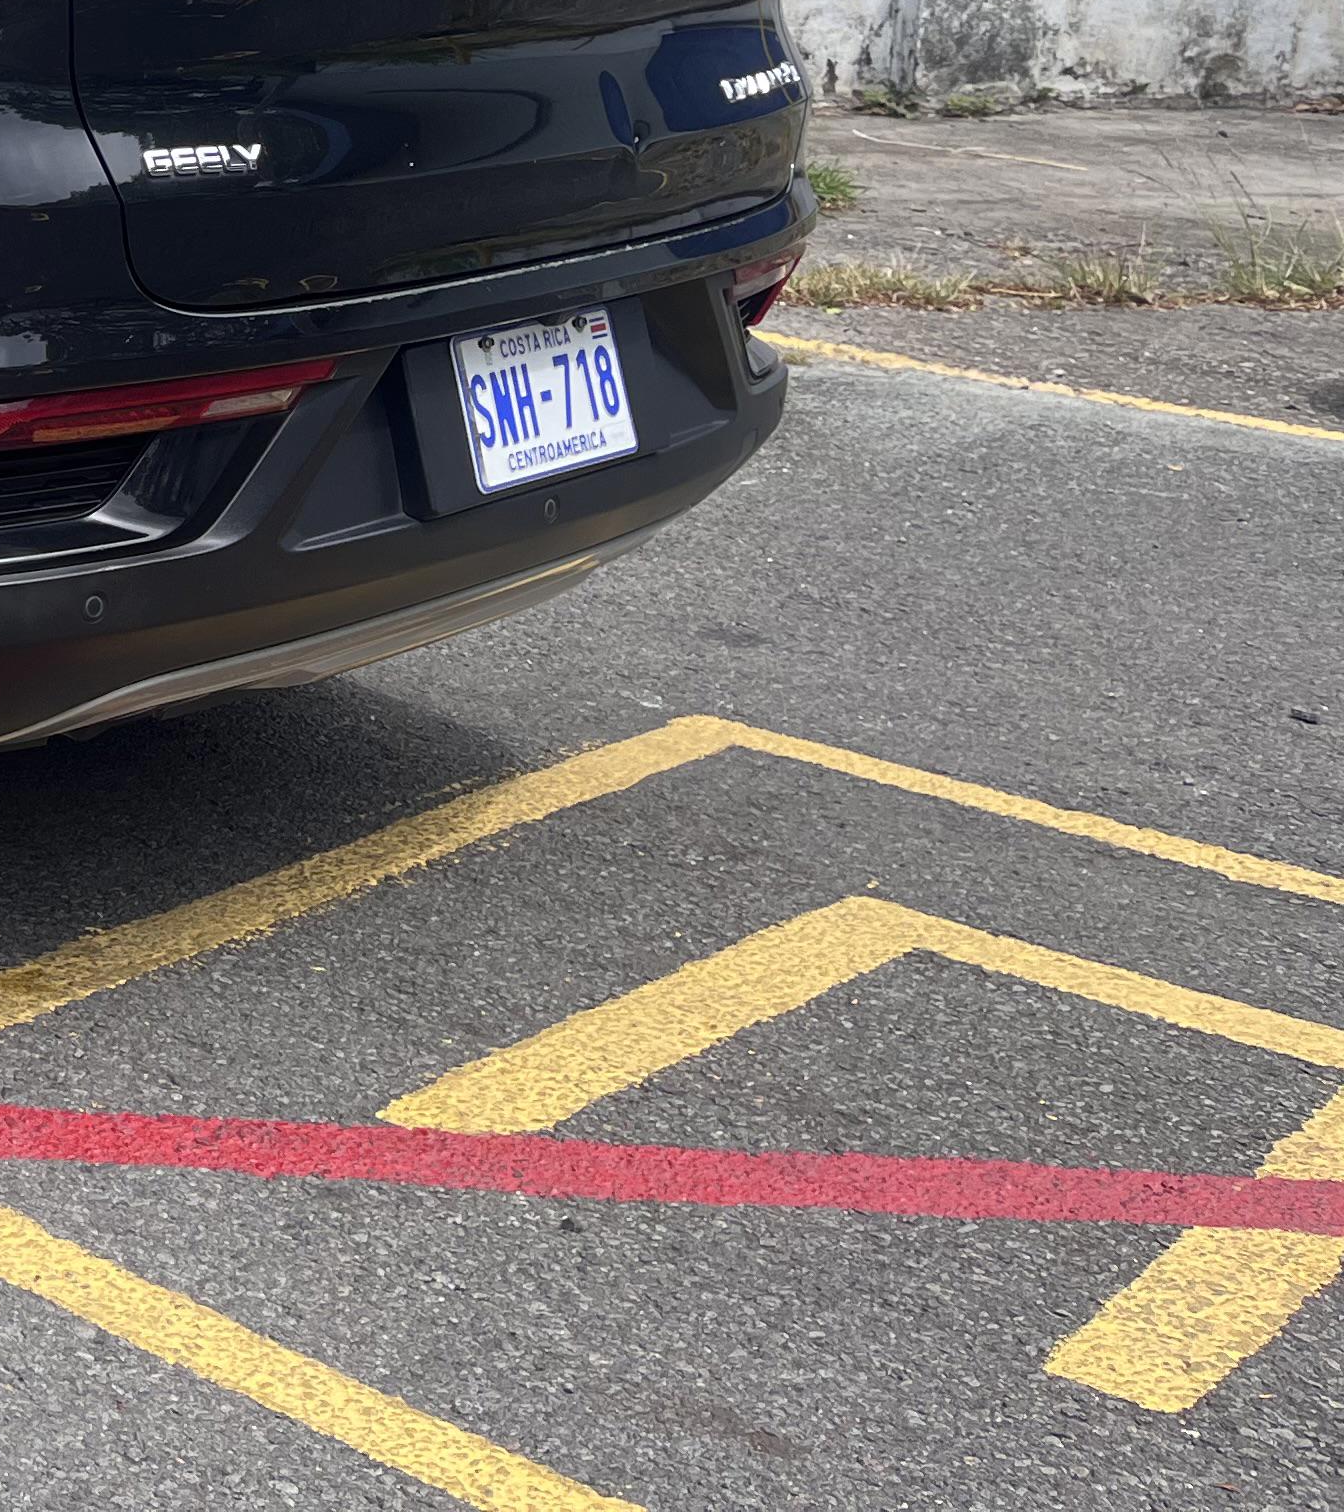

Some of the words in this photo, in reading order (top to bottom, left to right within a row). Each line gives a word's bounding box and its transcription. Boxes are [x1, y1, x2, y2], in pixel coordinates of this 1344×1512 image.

[142, 143, 262, 178] GEELY
[499, 333, 542, 359] COSTA
[542, 326, 572, 350] RICA
[470, 344, 621, 448] SNH-718
[507, 429, 608, 472] CENTROAMERICA
